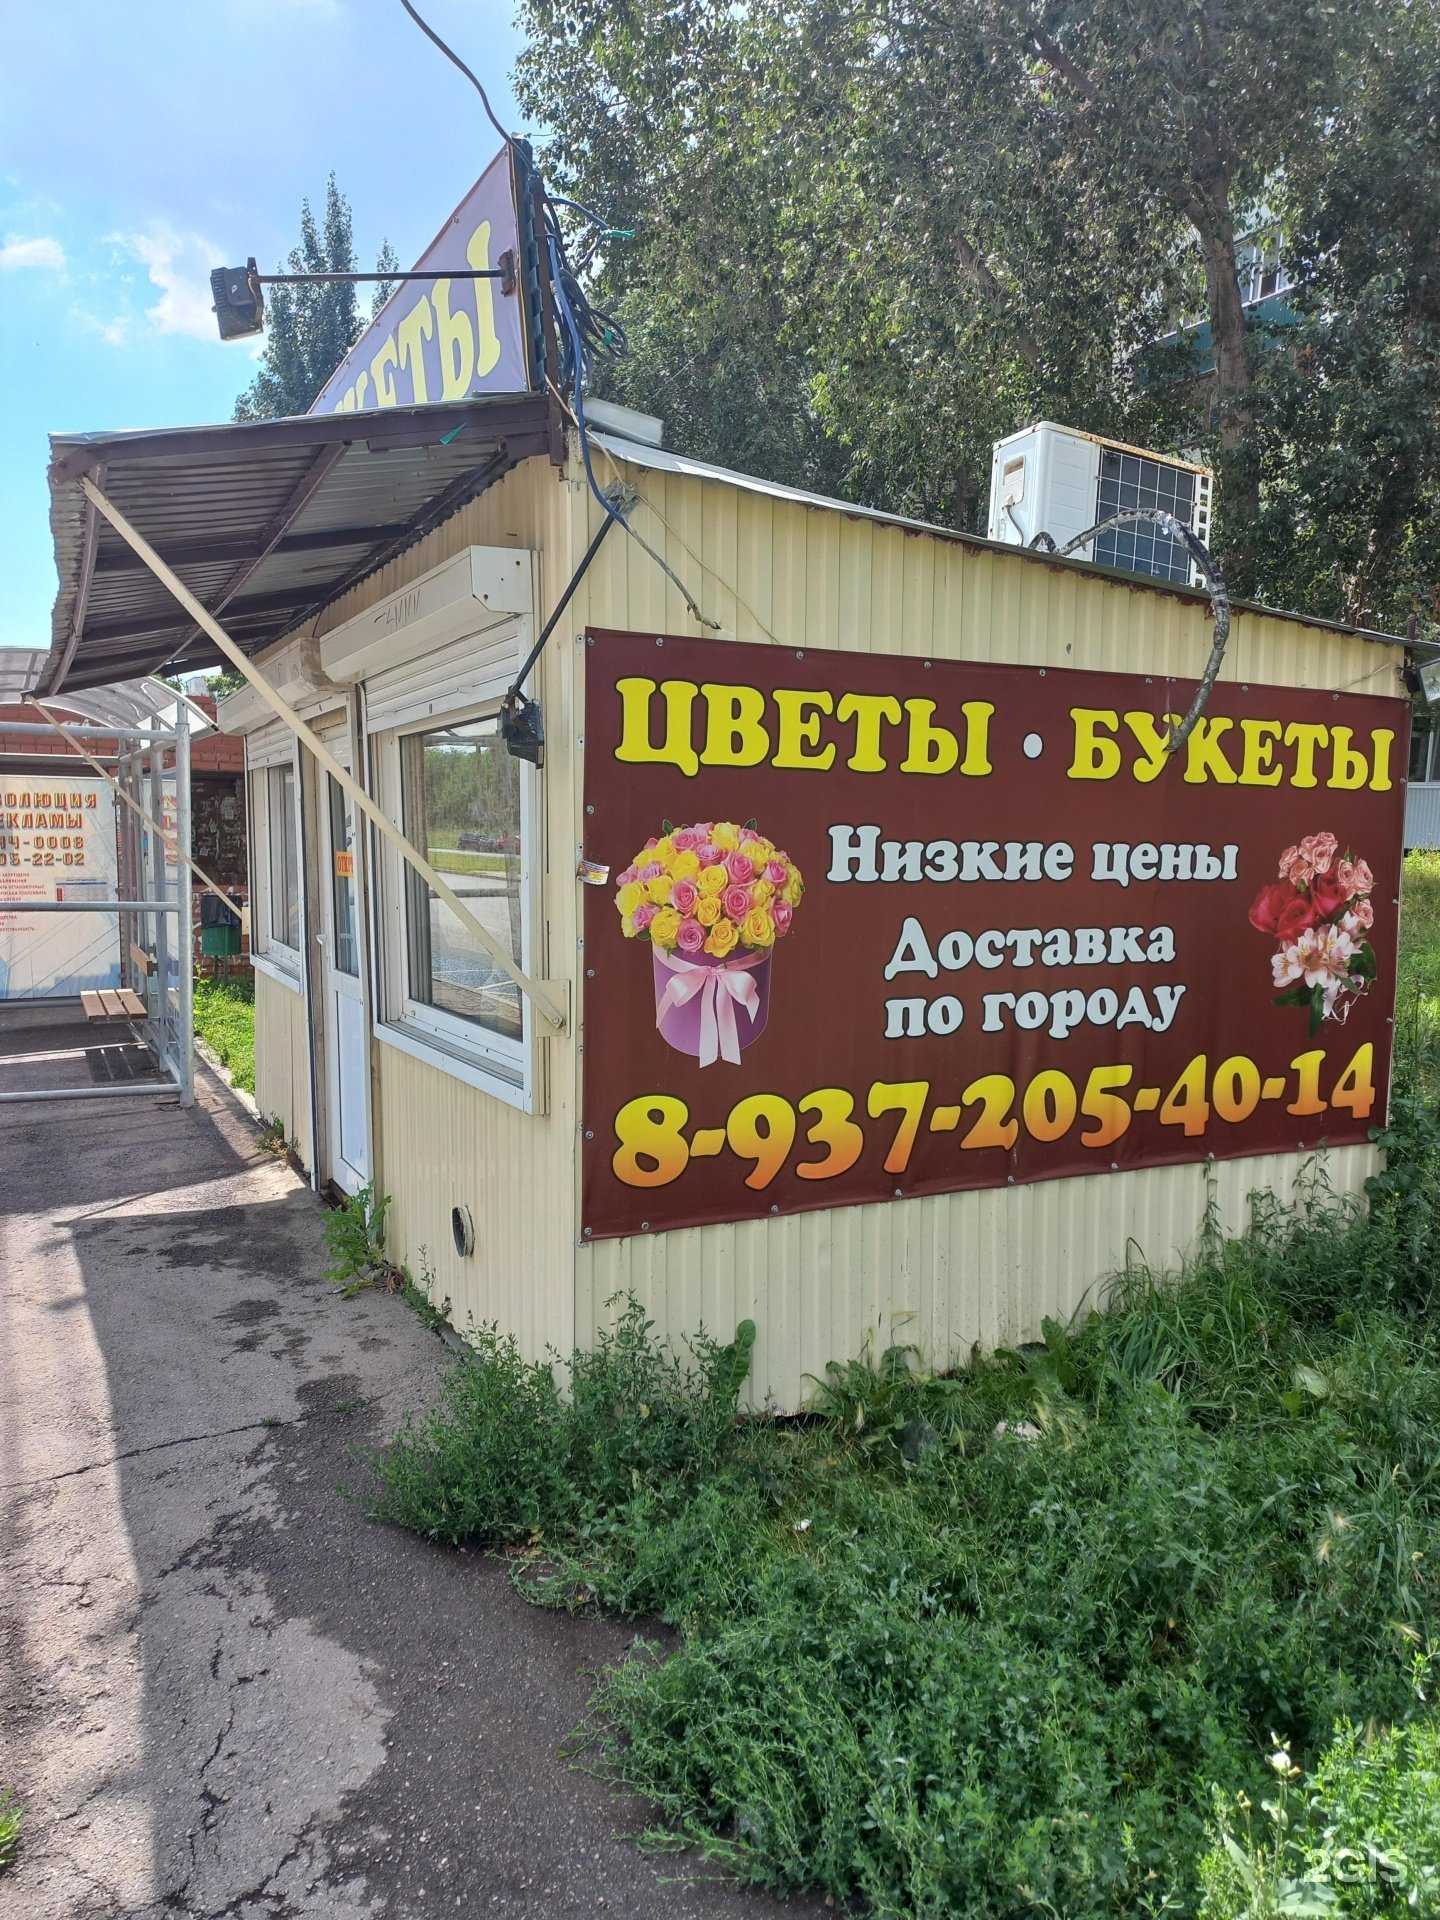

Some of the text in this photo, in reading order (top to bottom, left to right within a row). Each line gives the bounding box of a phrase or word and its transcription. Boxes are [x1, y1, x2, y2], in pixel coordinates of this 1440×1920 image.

[334, 219, 501, 412] ЕТЫ
[613, 676, 1395, 792] ЦВЕТЫ БУКЕТЫ
[0, 792, 97, 811] ОЛЮЦИЯ
[826, 824, 1240, 888] Низкие цены
[883, 916, 1177, 981] Доставка
[883, 984, 1187, 1039] по городу
[611, 1041, 1376, 1191] 8-937-205-40-14
